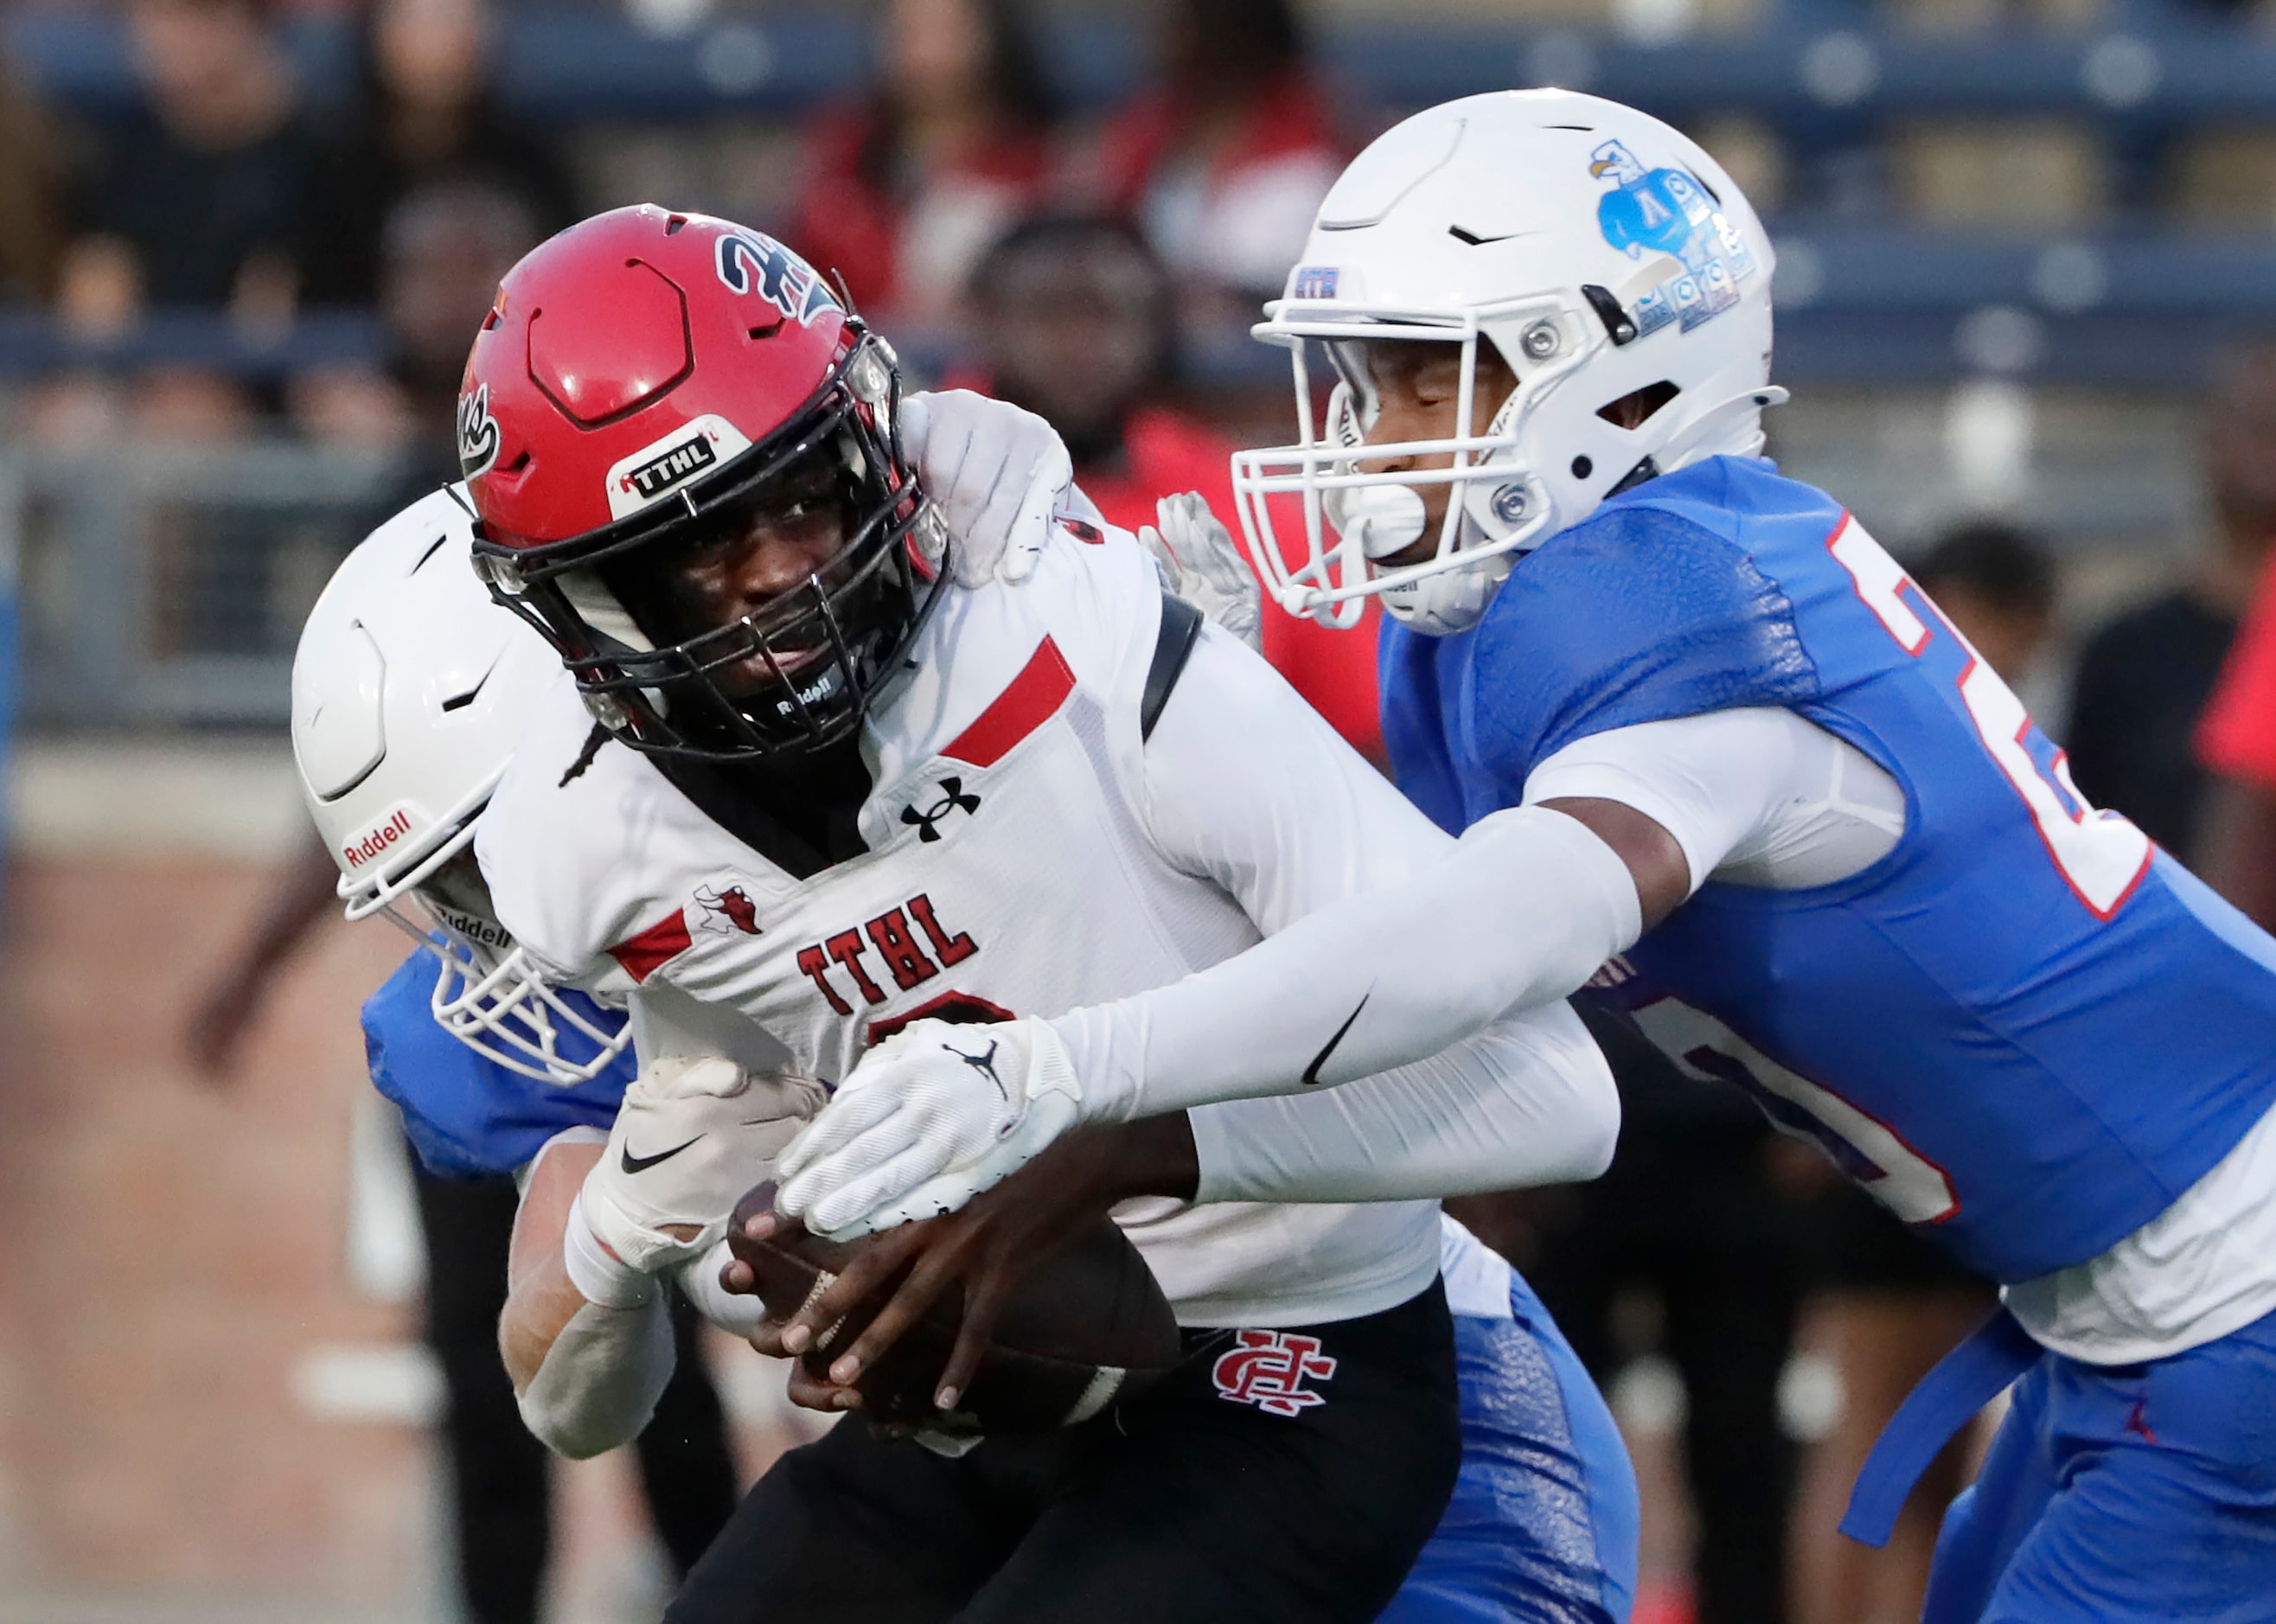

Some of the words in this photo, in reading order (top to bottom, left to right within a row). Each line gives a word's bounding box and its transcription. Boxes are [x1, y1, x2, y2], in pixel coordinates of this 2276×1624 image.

[634, 444, 710, 490] TTHL
[344, 809, 411, 868] Riddell
[796, 893, 979, 1016] TTHL
